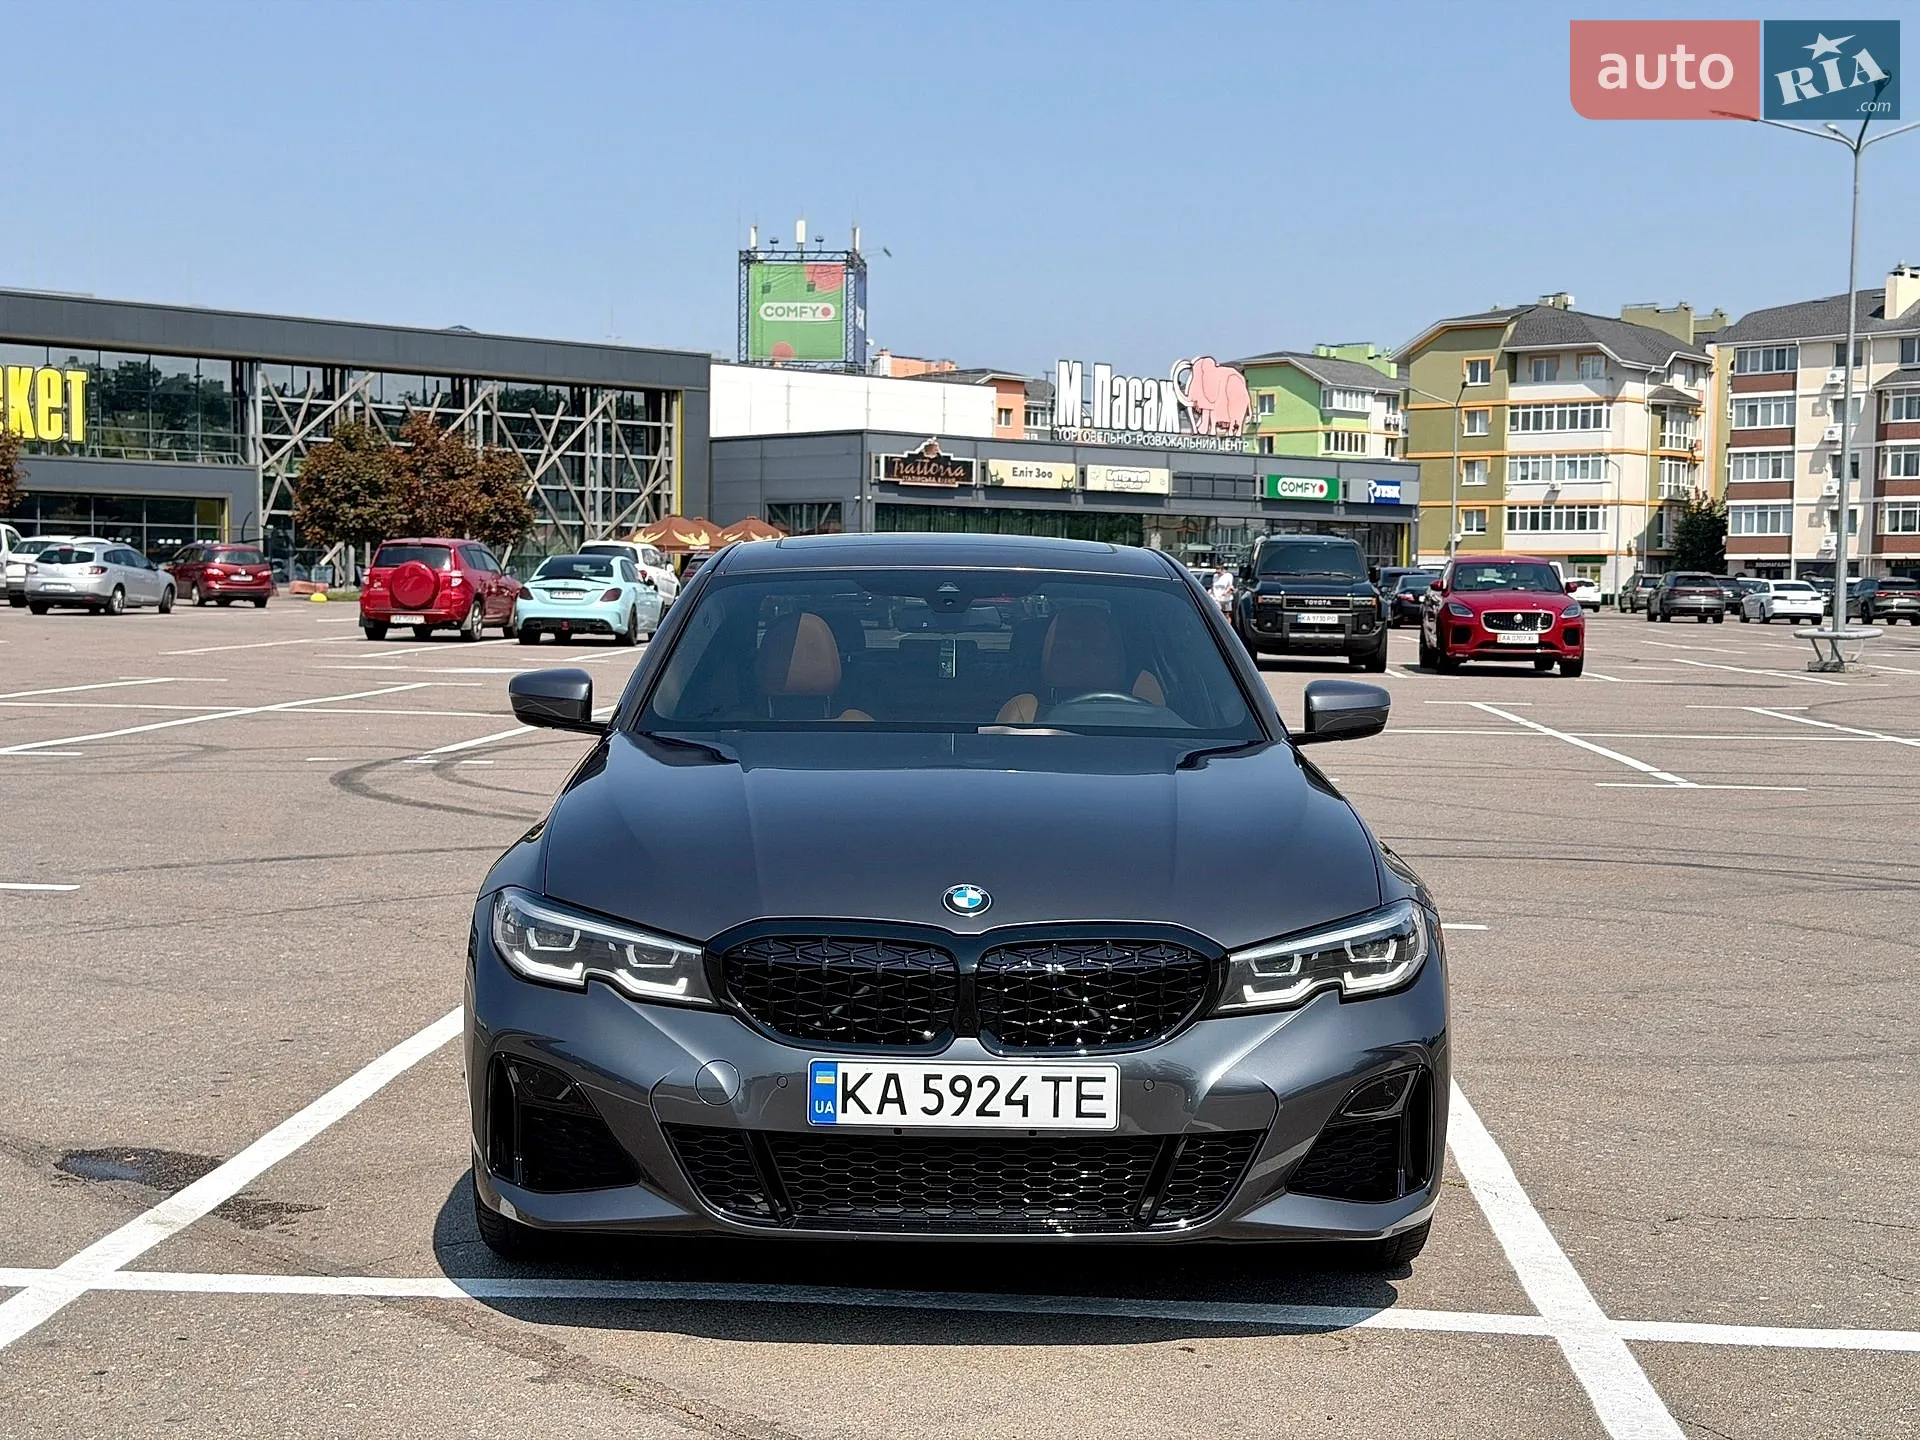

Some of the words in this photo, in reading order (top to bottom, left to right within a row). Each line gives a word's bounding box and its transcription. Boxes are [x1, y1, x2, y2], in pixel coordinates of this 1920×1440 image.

[763, 305, 820, 318] COMFY
[1218, 438, 1250, 452] ЦЕНТР
[891, 458, 966, 477] Trattoria
[1280, 481, 1318, 493] COMFY
[840, 1072, 907, 1115] KA
[920, 1073, 1029, 1118] 5924
[1041, 1075, 1107, 1119] TE
[815, 1101, 835, 1115] UA
